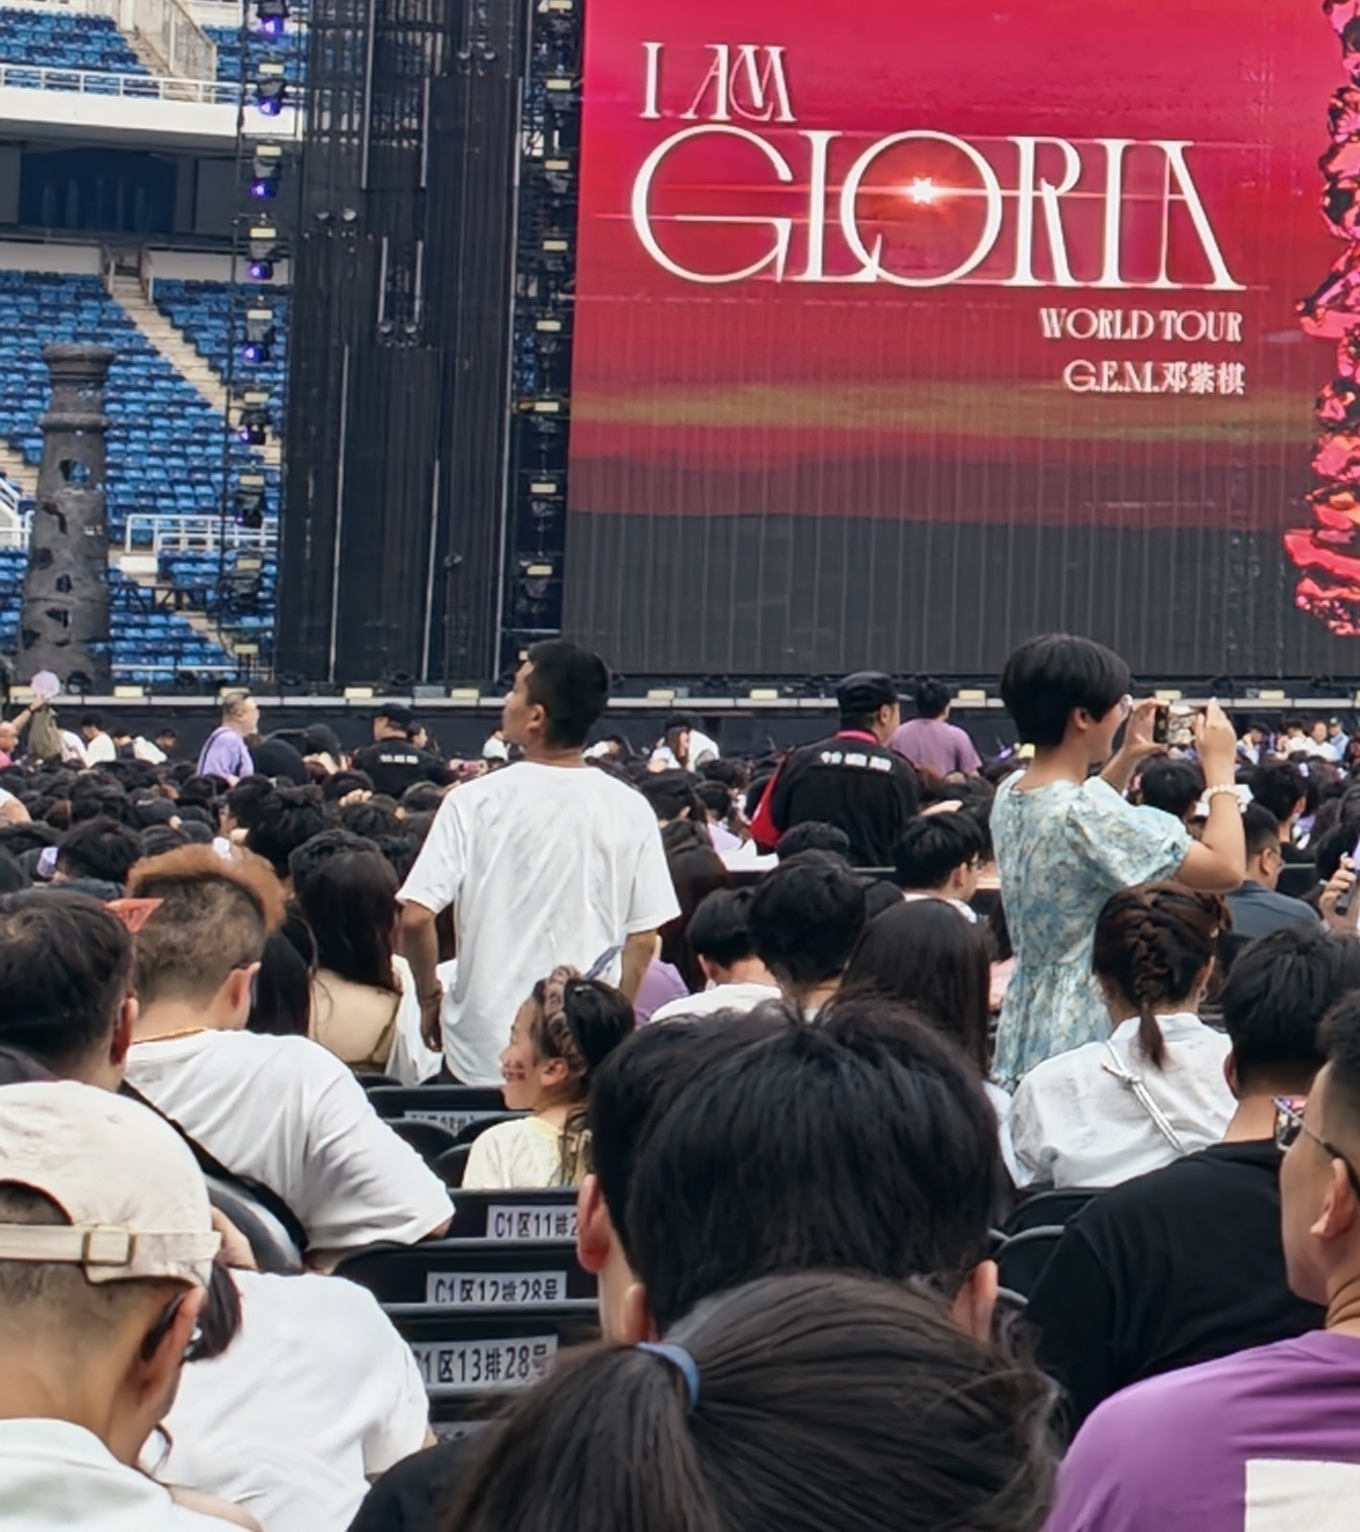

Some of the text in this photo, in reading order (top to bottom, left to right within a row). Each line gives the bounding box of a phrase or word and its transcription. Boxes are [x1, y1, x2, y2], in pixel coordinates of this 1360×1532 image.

[639, 41, 797, 122] I AM
[631, 123, 1247, 290] GLORIA
[1040, 307, 1244, 342] WORLD TOUR
[413, 1343, 547, 1383] 1区13排28号
